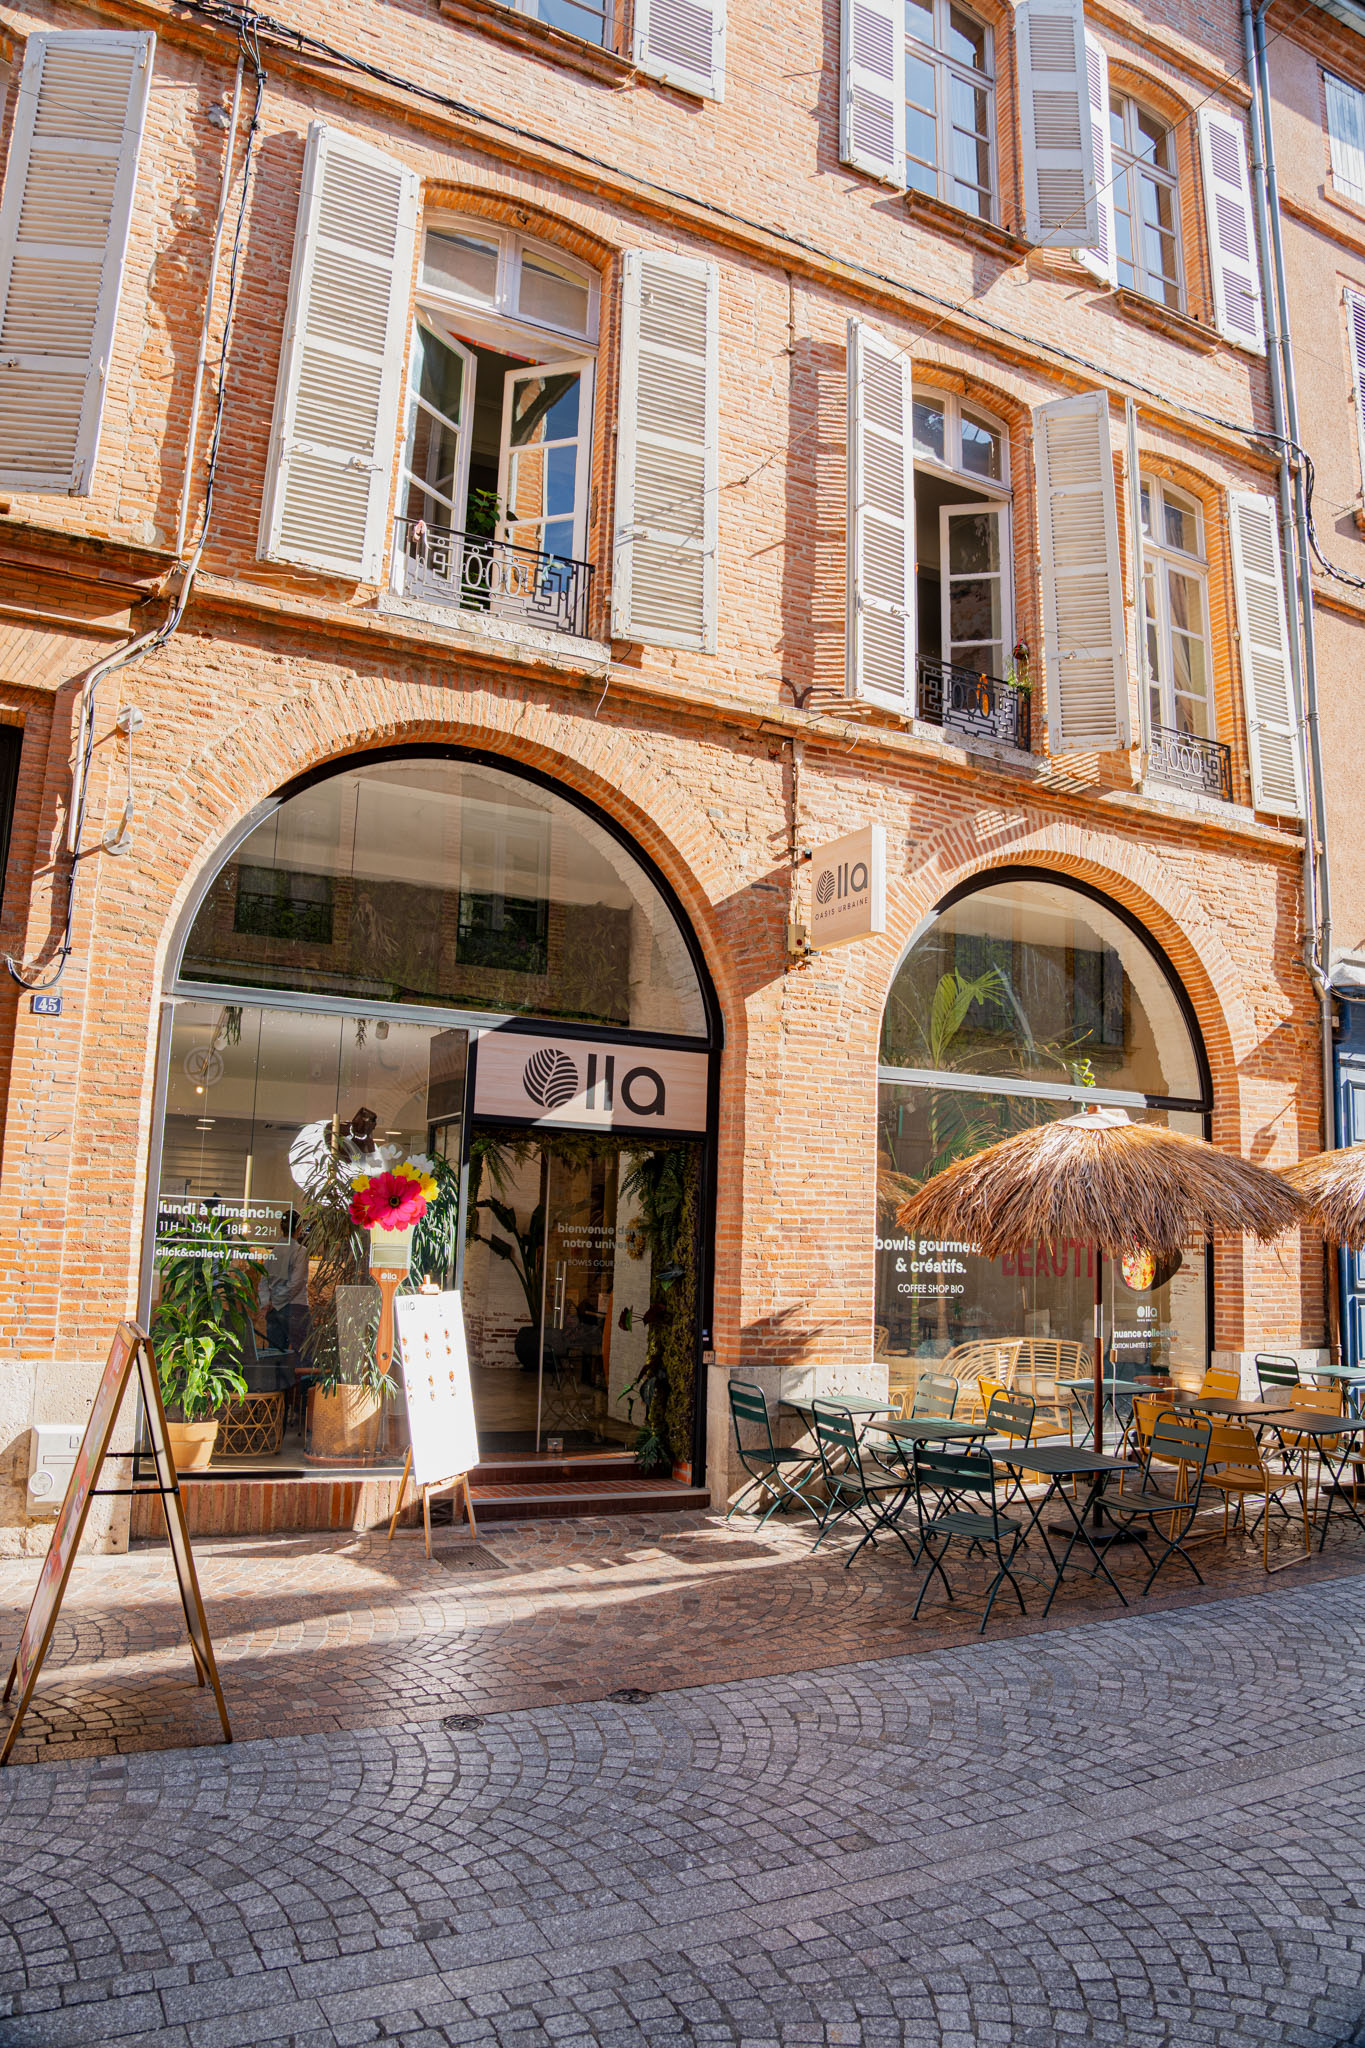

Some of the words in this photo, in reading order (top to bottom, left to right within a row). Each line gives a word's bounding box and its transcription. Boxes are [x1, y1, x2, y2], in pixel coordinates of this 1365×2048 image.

[816, 862, 867, 904] Olla
[815, 908, 835, 920] OASIS
[838, 896, 868, 912] URBAINE
[38, 997, 58, 1012] 45
[522, 1048, 666, 1117] Olla
[159, 1200, 196, 1215] lundi
[199, 1202, 208, 1216] à
[211, 1203, 287, 1219] dimanche.
[159, 1220, 179, 1232] 11H
[191, 1222, 211, 1234] 15H
[254, 1225, 278, 1237] 22H
[557, 1222, 615, 1235] bienvenue
[562, 1239, 592, 1249] notre
[874, 1234, 916, 1251] bowls
[155, 1246, 225, 1259] click&collect
[232, 1249, 278, 1261] livraison.
[895, 1257, 908, 1273] &
[910, 1257, 967, 1274] créatifs.
[897, 1283, 927, 1293] COFFEE
[928, 1283, 949, 1294] SHOP
[950, 1284, 965, 1294] BIO
